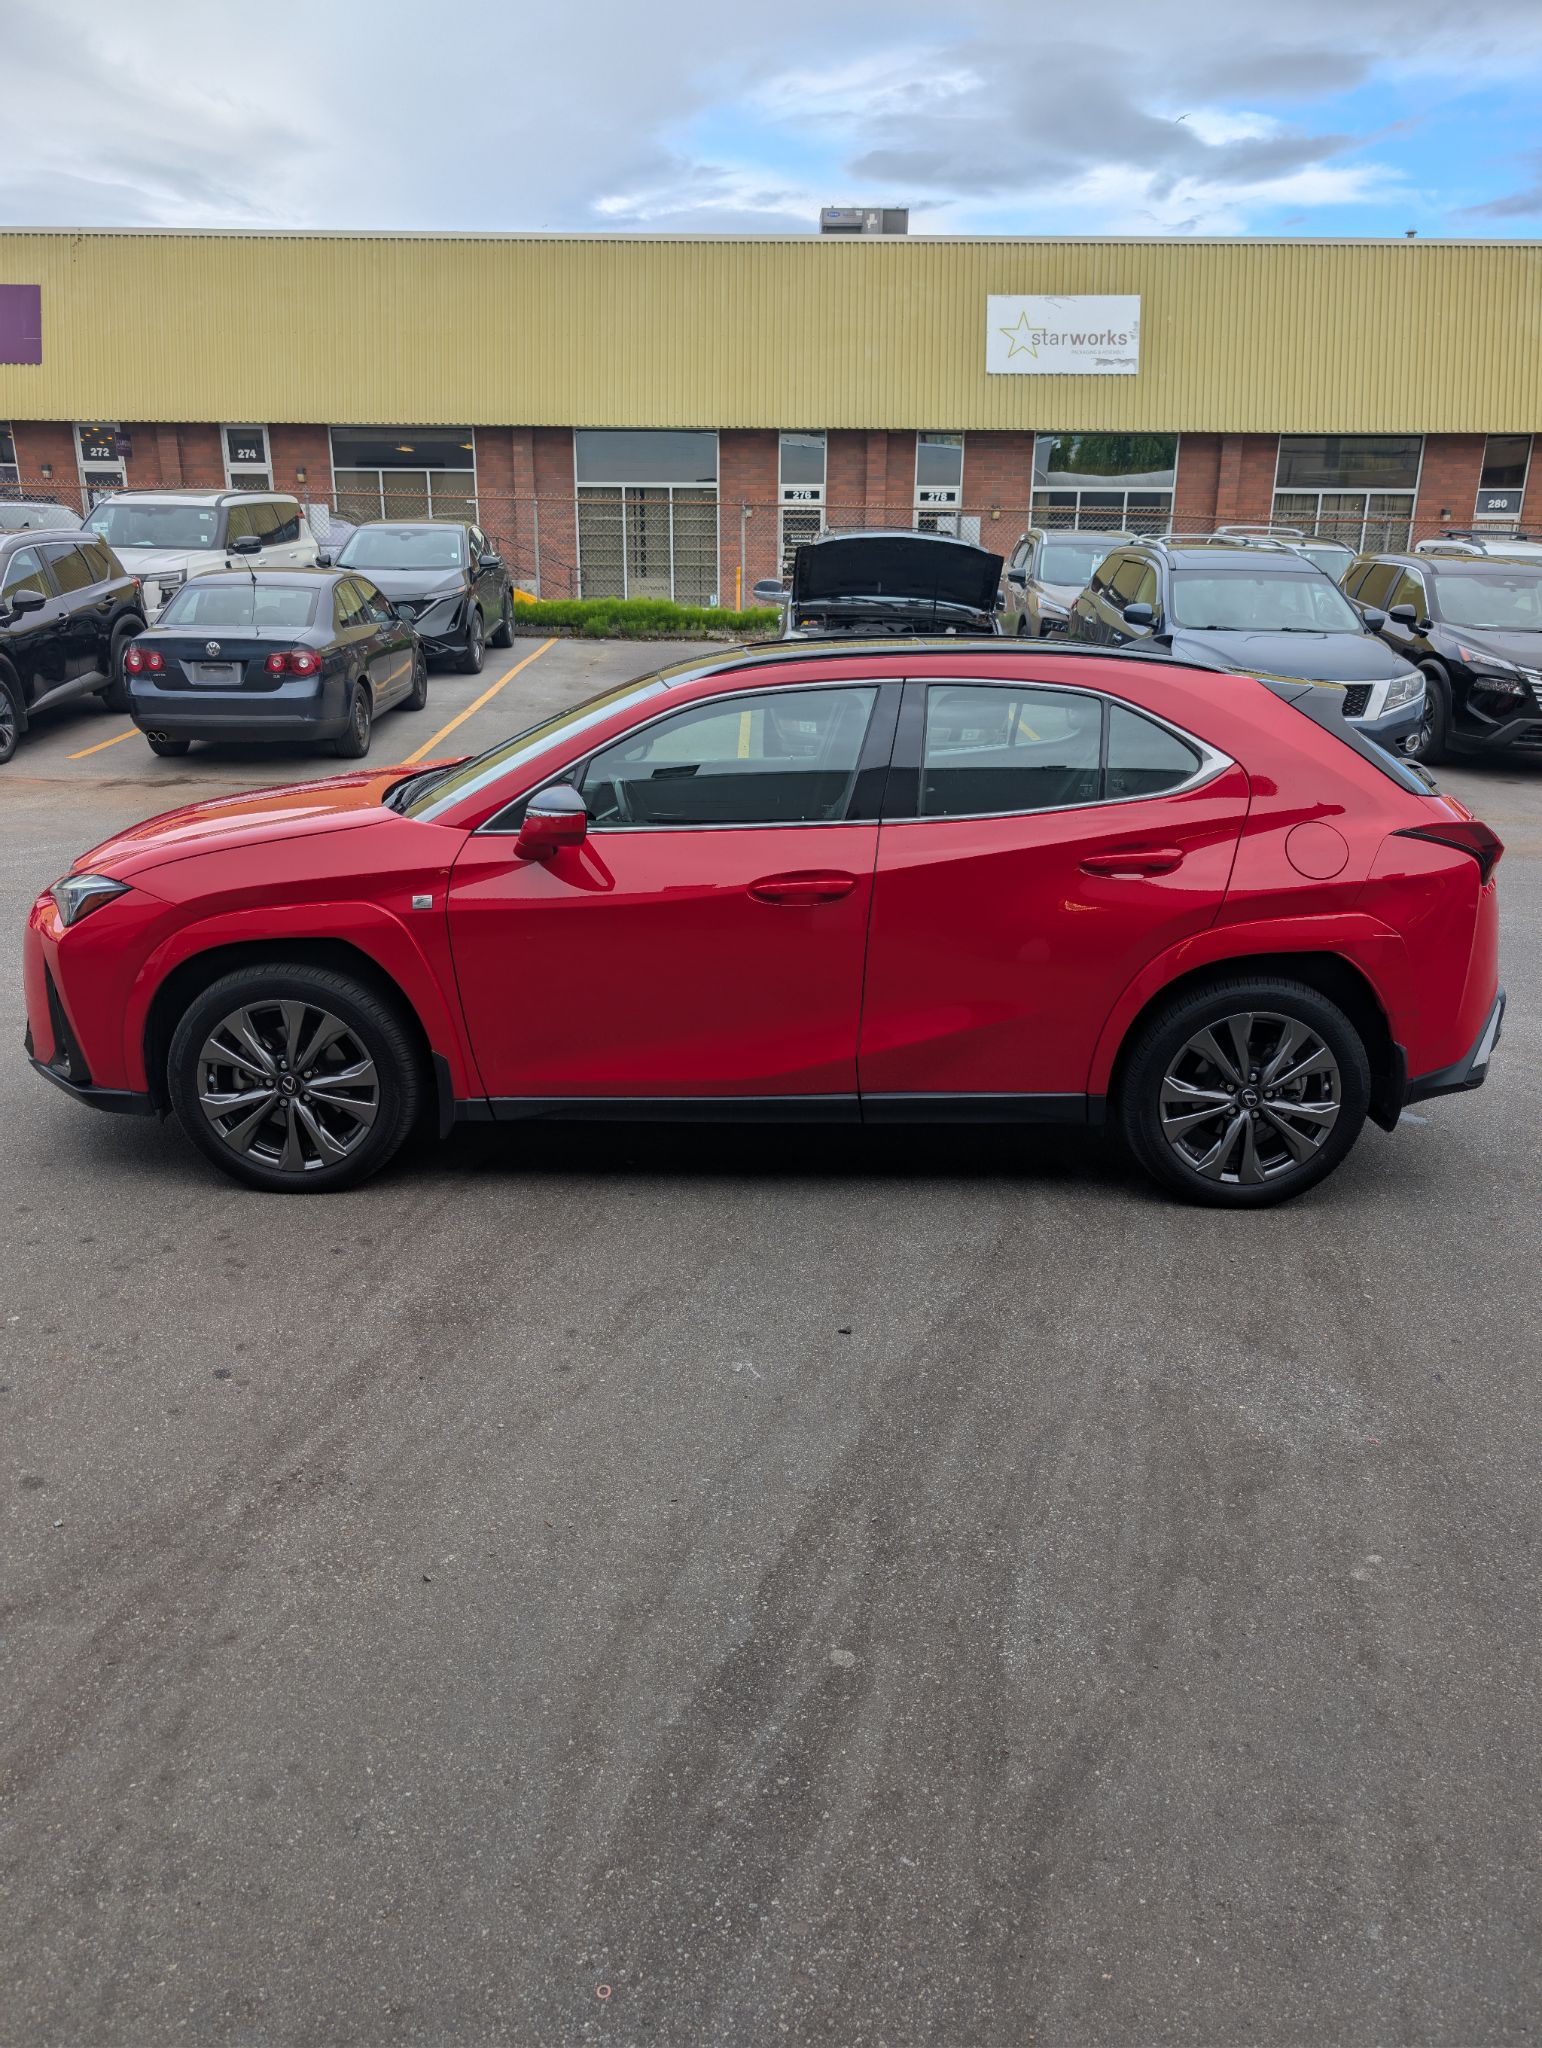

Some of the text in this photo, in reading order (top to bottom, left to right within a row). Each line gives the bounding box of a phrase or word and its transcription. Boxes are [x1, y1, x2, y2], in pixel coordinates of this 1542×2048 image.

[1031, 329, 1128, 346] starworks
[90, 447, 110, 457] 272
[237, 448, 257, 459] 274
[792, 491, 812, 500] 276
[928, 492, 948, 502] 278
[1487, 499, 1508, 509] 280
